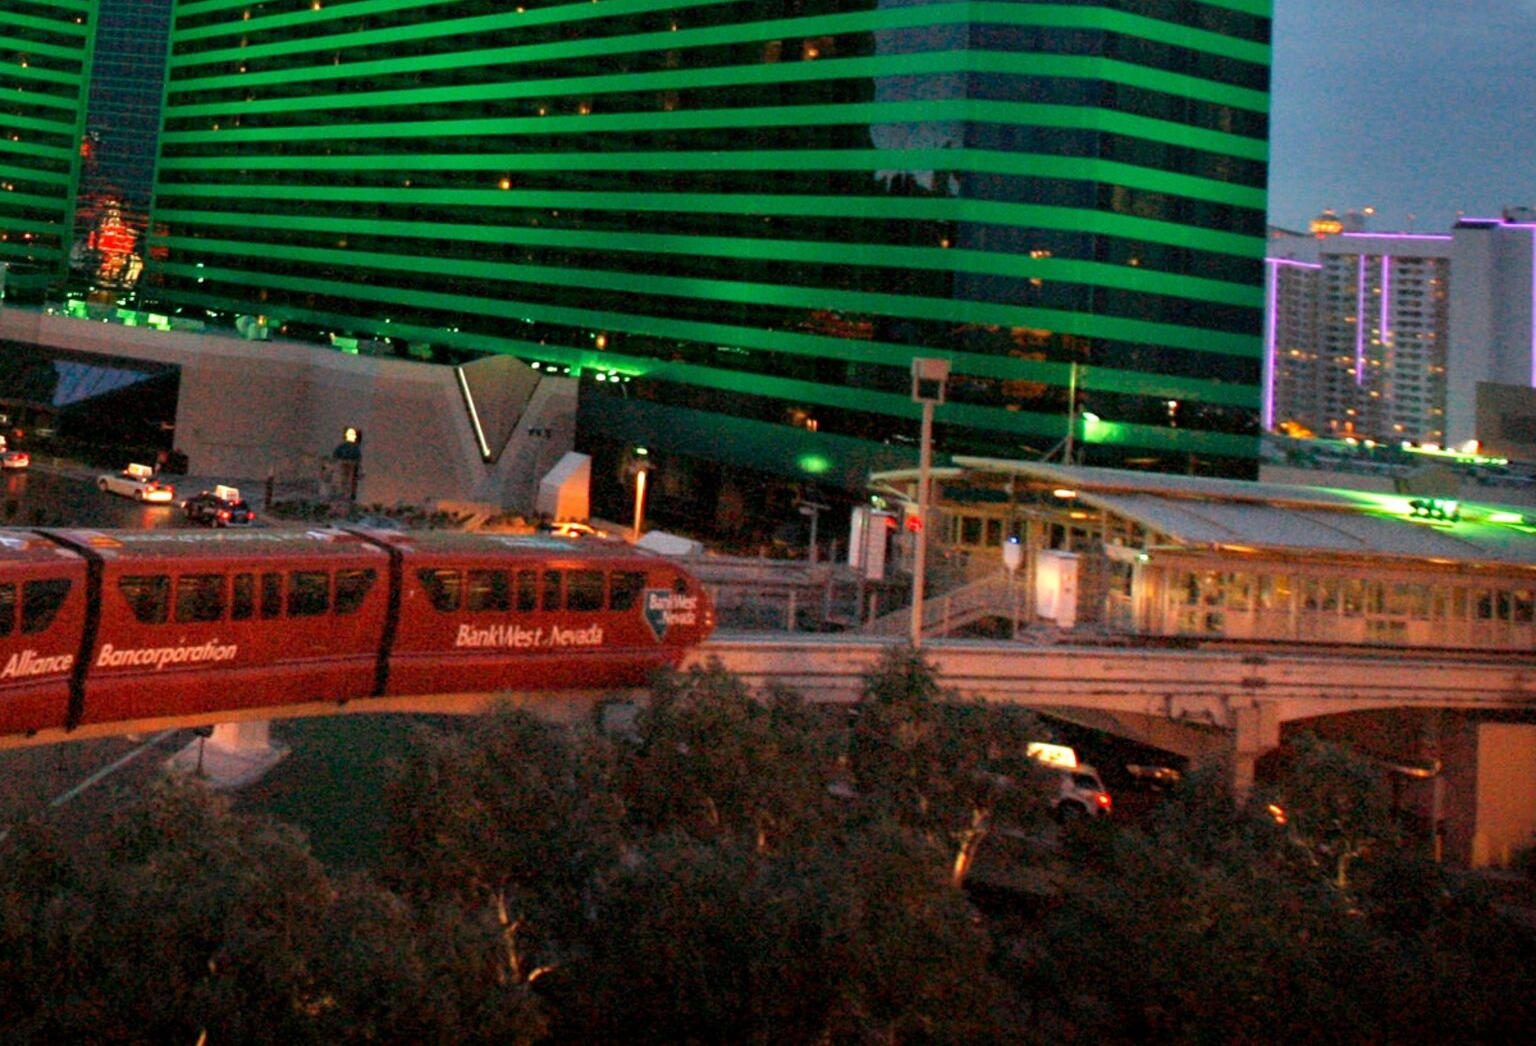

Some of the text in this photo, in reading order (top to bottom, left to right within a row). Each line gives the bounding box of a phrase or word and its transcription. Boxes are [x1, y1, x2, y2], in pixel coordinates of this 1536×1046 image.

[456, 623, 604, 647] BankWest Nevada
[0, 650, 74, 679] Alliance
[96, 638, 238, 668] Bancorporation
